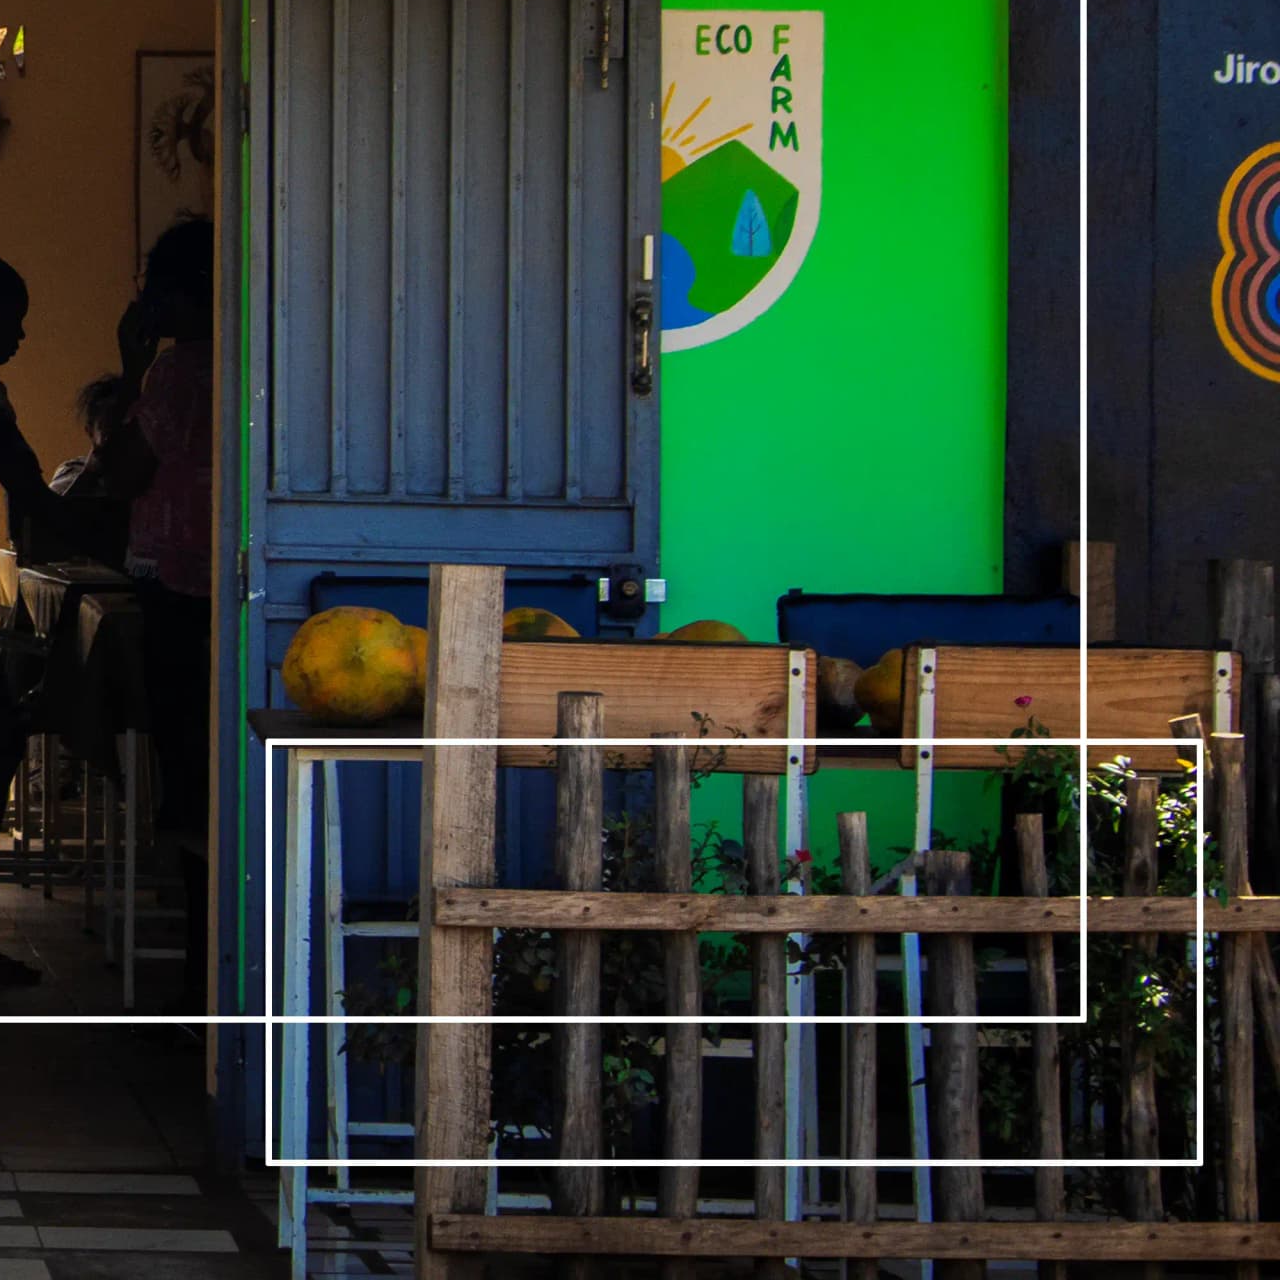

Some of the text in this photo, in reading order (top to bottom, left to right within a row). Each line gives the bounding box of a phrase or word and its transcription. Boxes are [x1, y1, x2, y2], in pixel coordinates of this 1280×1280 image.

[696, 24, 753, 55] ECO
[1213, 53, 1280, 86] Jiro
[769, 24, 800, 153] FARM
